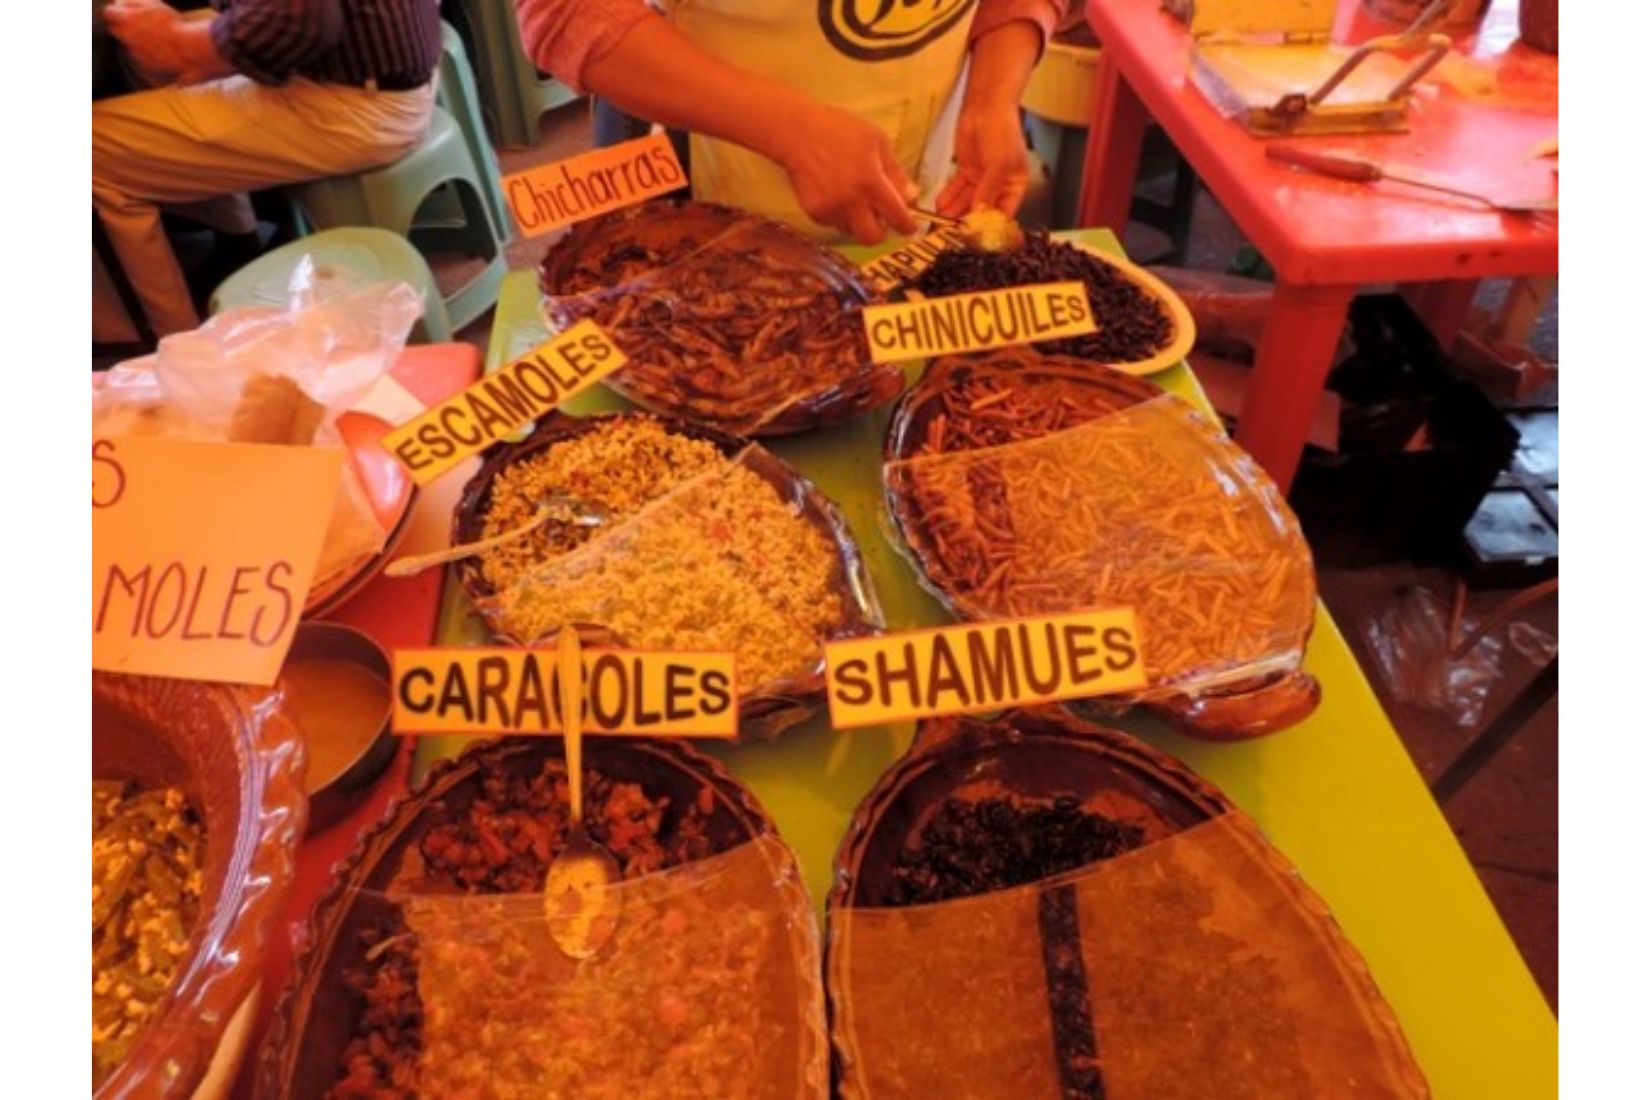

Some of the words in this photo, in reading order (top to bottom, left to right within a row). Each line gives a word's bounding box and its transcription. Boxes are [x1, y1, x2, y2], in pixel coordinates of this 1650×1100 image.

[509, 147, 680, 229] Chicharras
[871, 292, 1086, 351] CHINICUILES
[395, 334, 611, 470] ESCAMOLES
[95, 560, 294, 647] MOLES
[834, 623, 1137, 709] SHAMUES
